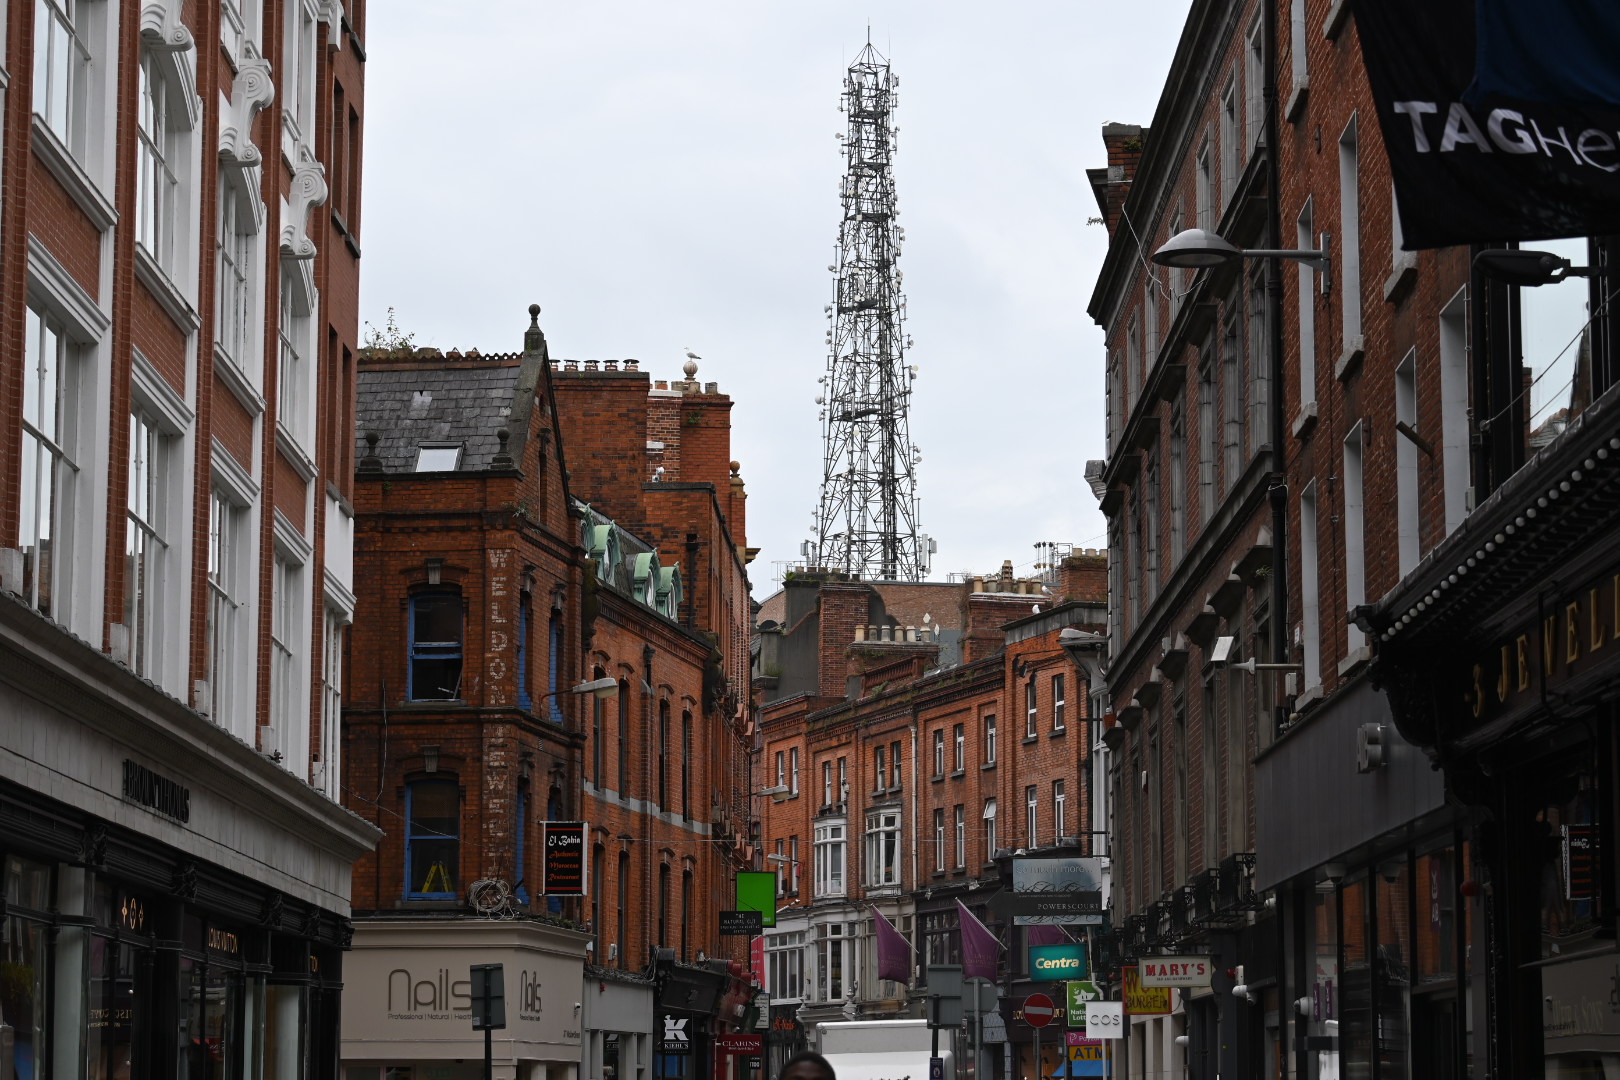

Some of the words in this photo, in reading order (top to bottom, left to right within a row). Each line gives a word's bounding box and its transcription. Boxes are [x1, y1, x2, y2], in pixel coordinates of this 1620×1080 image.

[1393, 101, 1620, 172] TAGHe
[548, 835, 557, 847] El
[1035, 957, 1080, 969] Centra
[1145, 963, 1205, 977] MARY'S
[1089, 1014, 1120, 1026] COS
